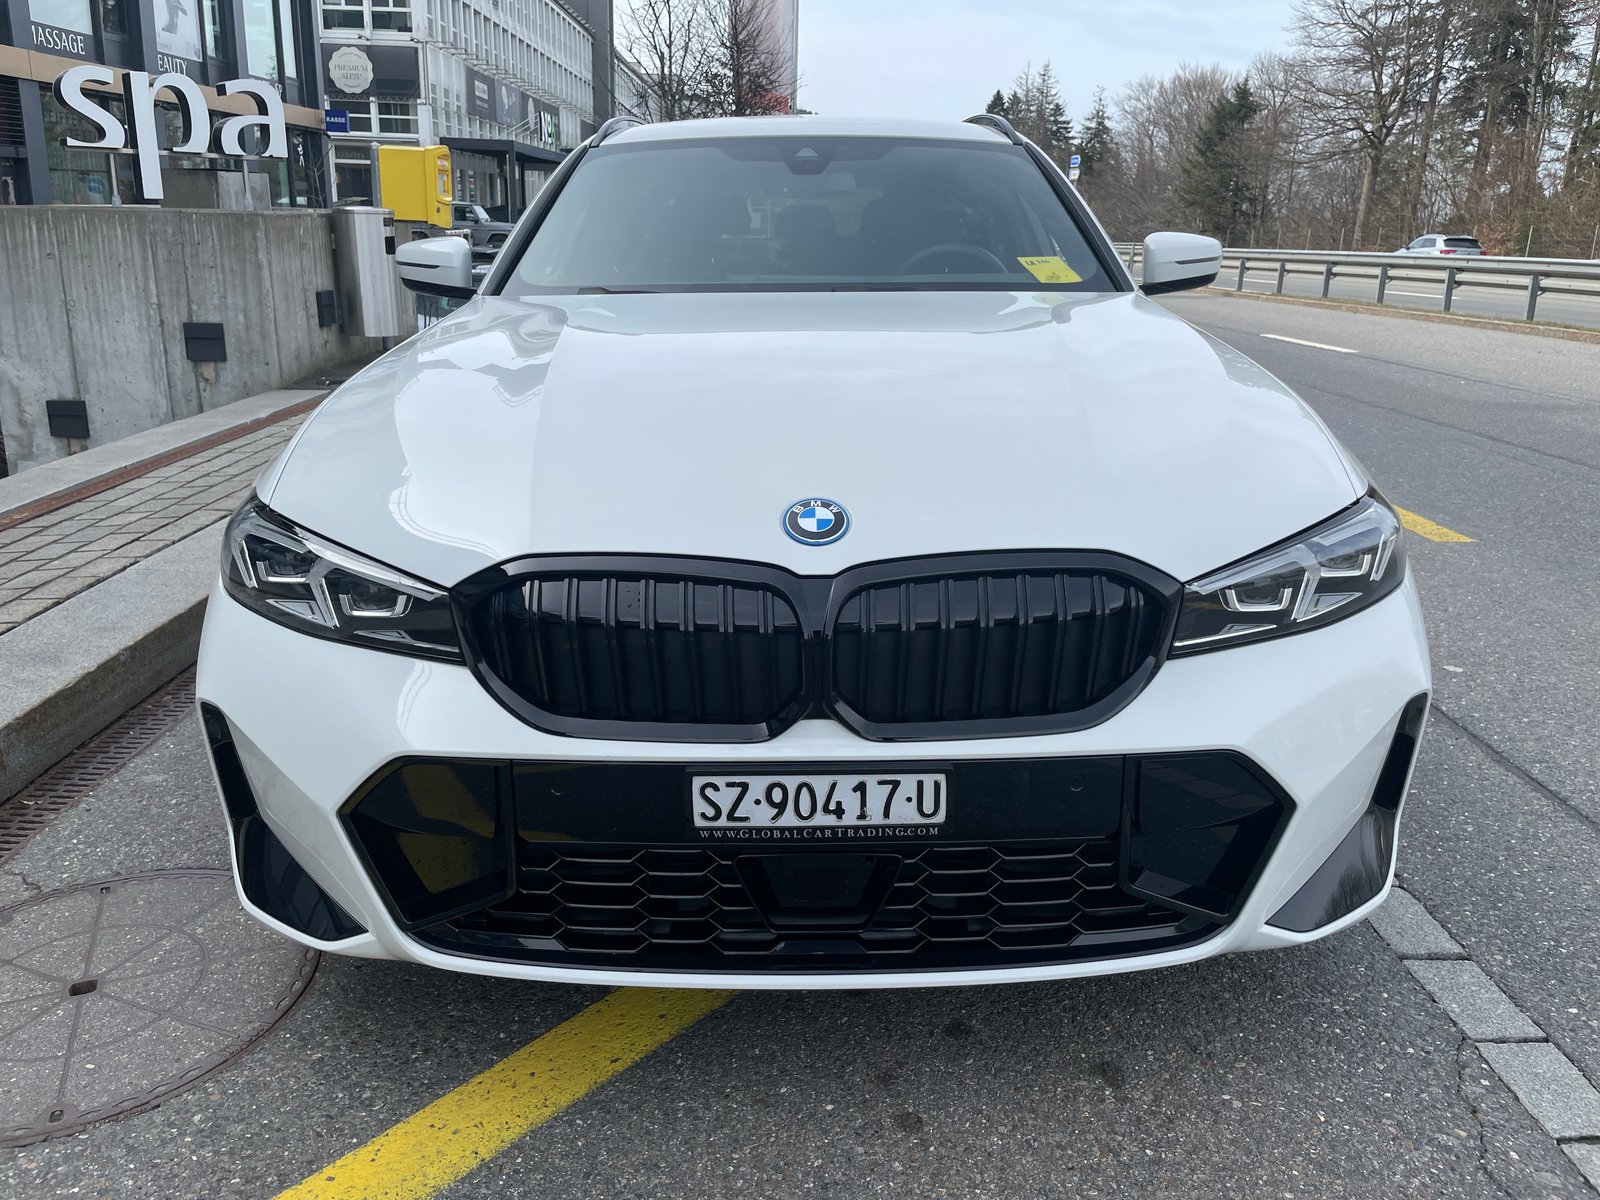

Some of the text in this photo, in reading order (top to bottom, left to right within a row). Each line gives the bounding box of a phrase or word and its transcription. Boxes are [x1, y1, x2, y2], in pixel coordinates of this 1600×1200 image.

[32, 25, 85, 54] ASSAGE
[54, 65, 288, 199] spa
[792, 500, 841, 513] BMW
